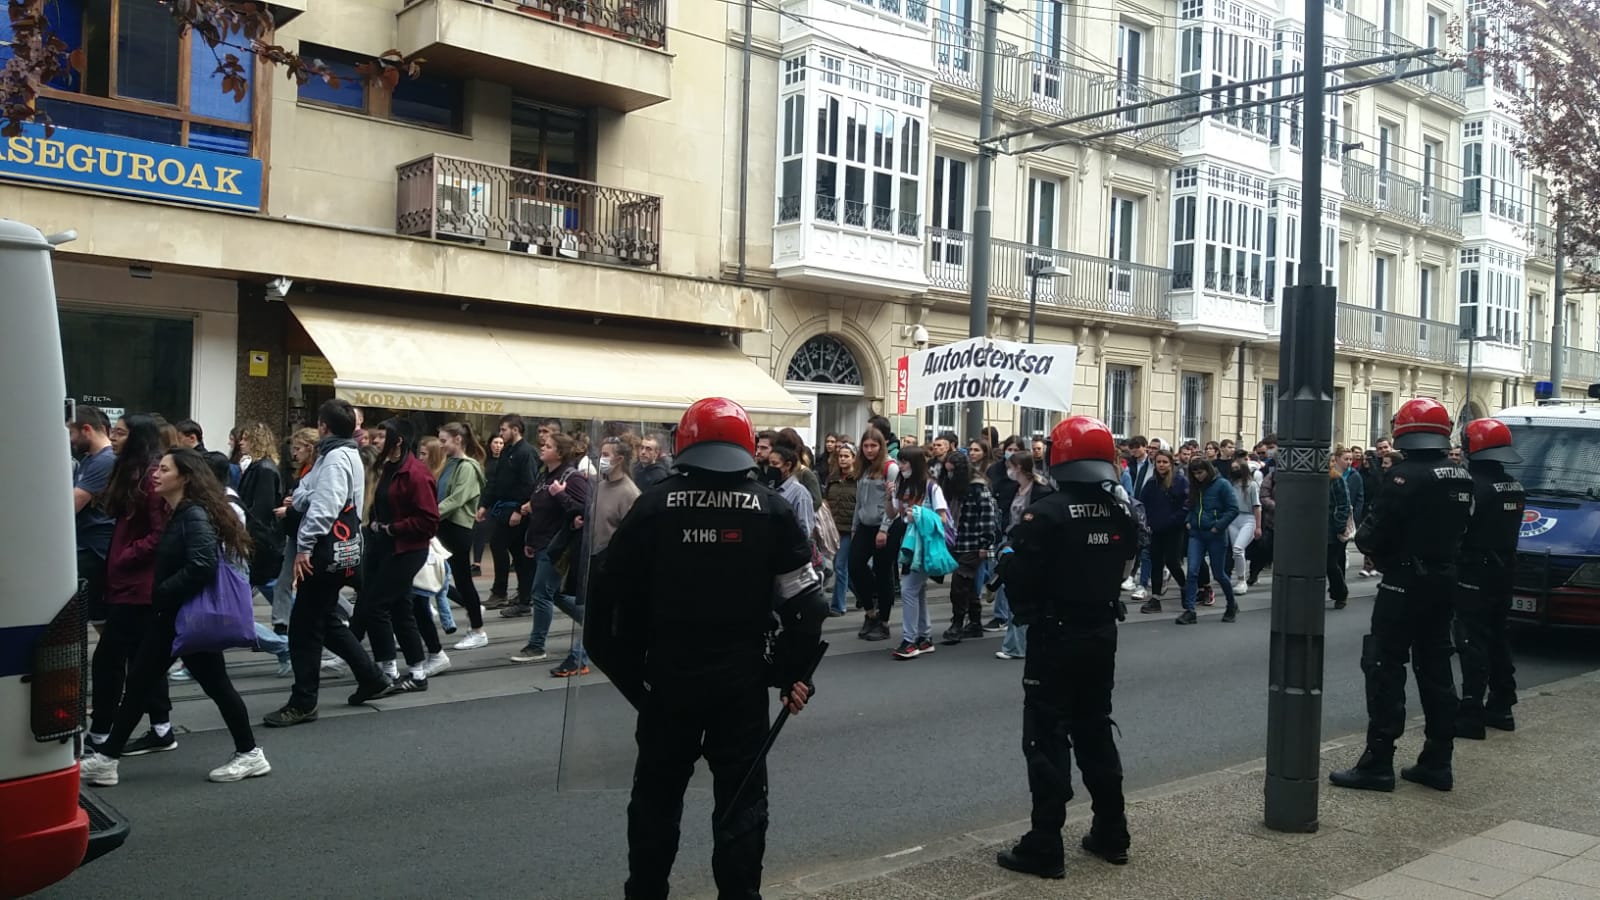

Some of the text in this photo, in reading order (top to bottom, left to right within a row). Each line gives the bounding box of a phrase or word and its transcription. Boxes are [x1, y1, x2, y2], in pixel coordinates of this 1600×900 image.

[0, 136, 243, 195] SEGUROAK
[354, 392, 434, 409] MORANT
[666, 490, 761, 511] ERTZAINTZA
[682, 529, 717, 543] X1H6
[1087, 533, 1109, 545] A9X6
